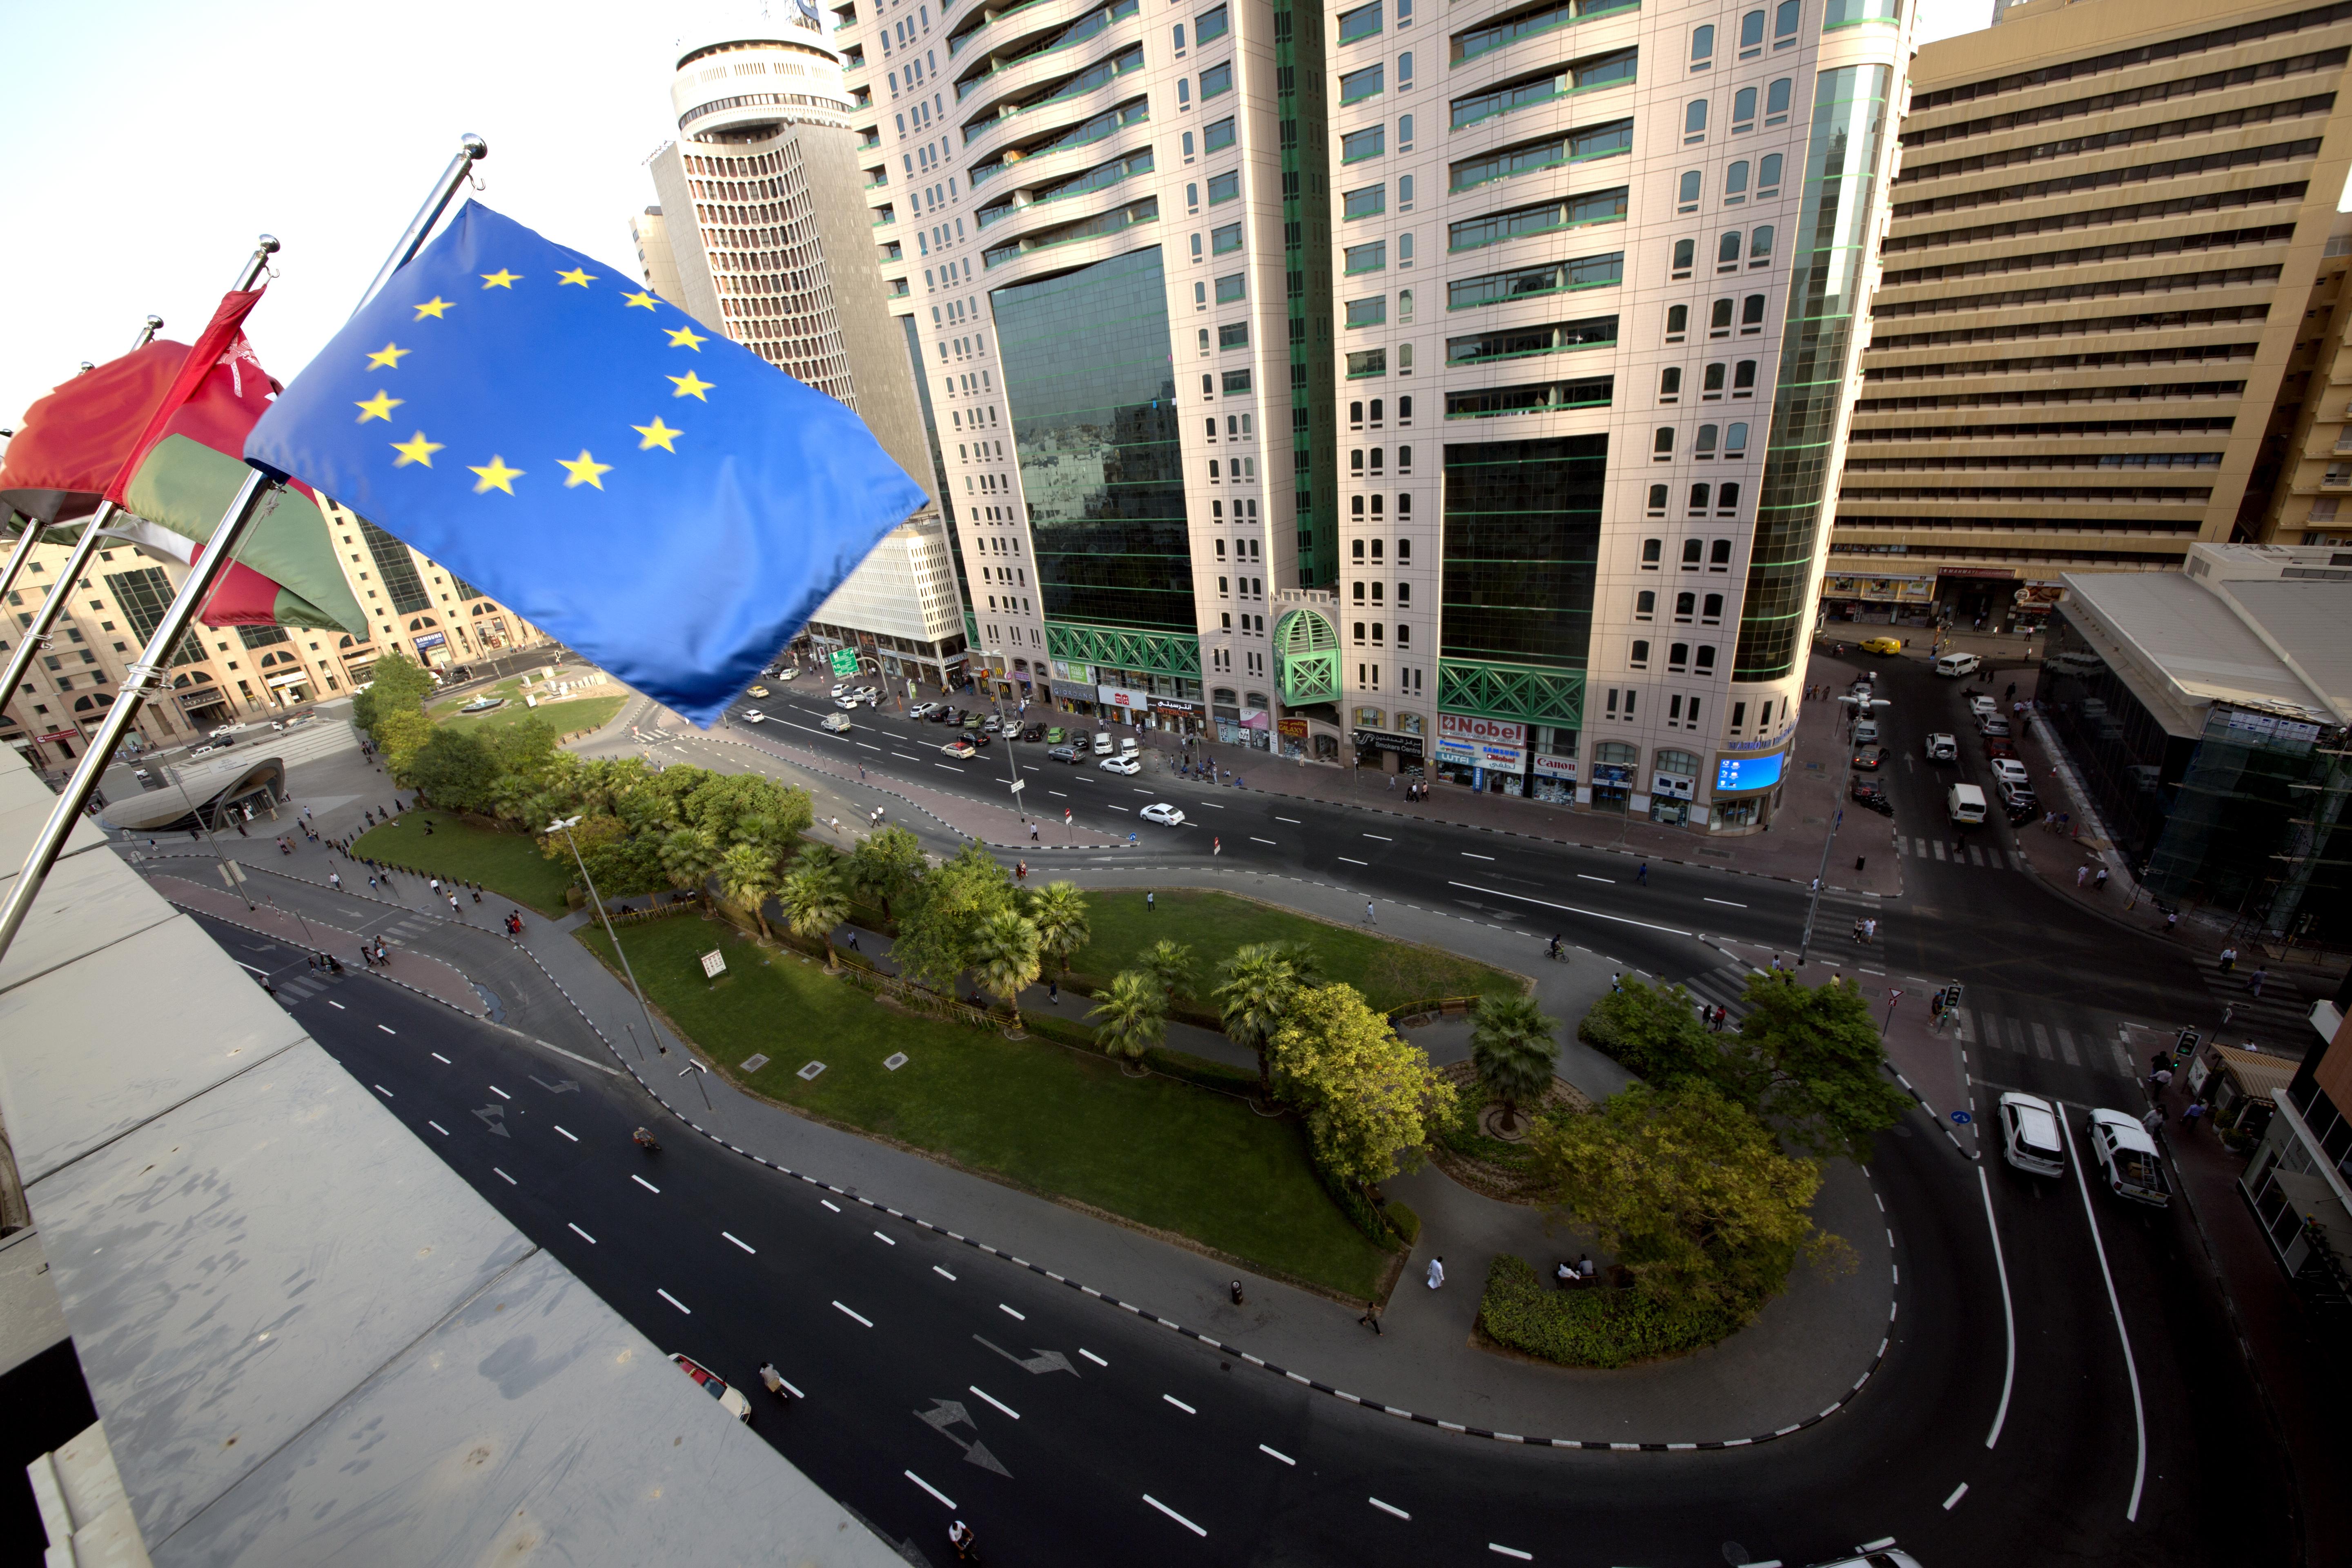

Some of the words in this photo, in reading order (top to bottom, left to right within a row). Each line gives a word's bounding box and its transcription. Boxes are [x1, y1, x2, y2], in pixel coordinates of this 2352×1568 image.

[416, 633, 442, 643] SAMSUNG
[944, 655, 962, 664] LEADER
[1054, 688, 1093, 699] GIORDANO
[1278, 725, 1303, 733] GALAXY
[1458, 717, 1522, 740] Nobel
[1375, 742, 1400, 751] Smokers
[1401, 746, 1421, 754] Centre
[1439, 740, 1474, 750] Panasonic
[1483, 746, 1520, 757] SAMSUNG
[1441, 754, 1469, 764] LUTFI
[1493, 755, 1515, 763] Nobel
[1537, 758, 1575, 771] Canon
